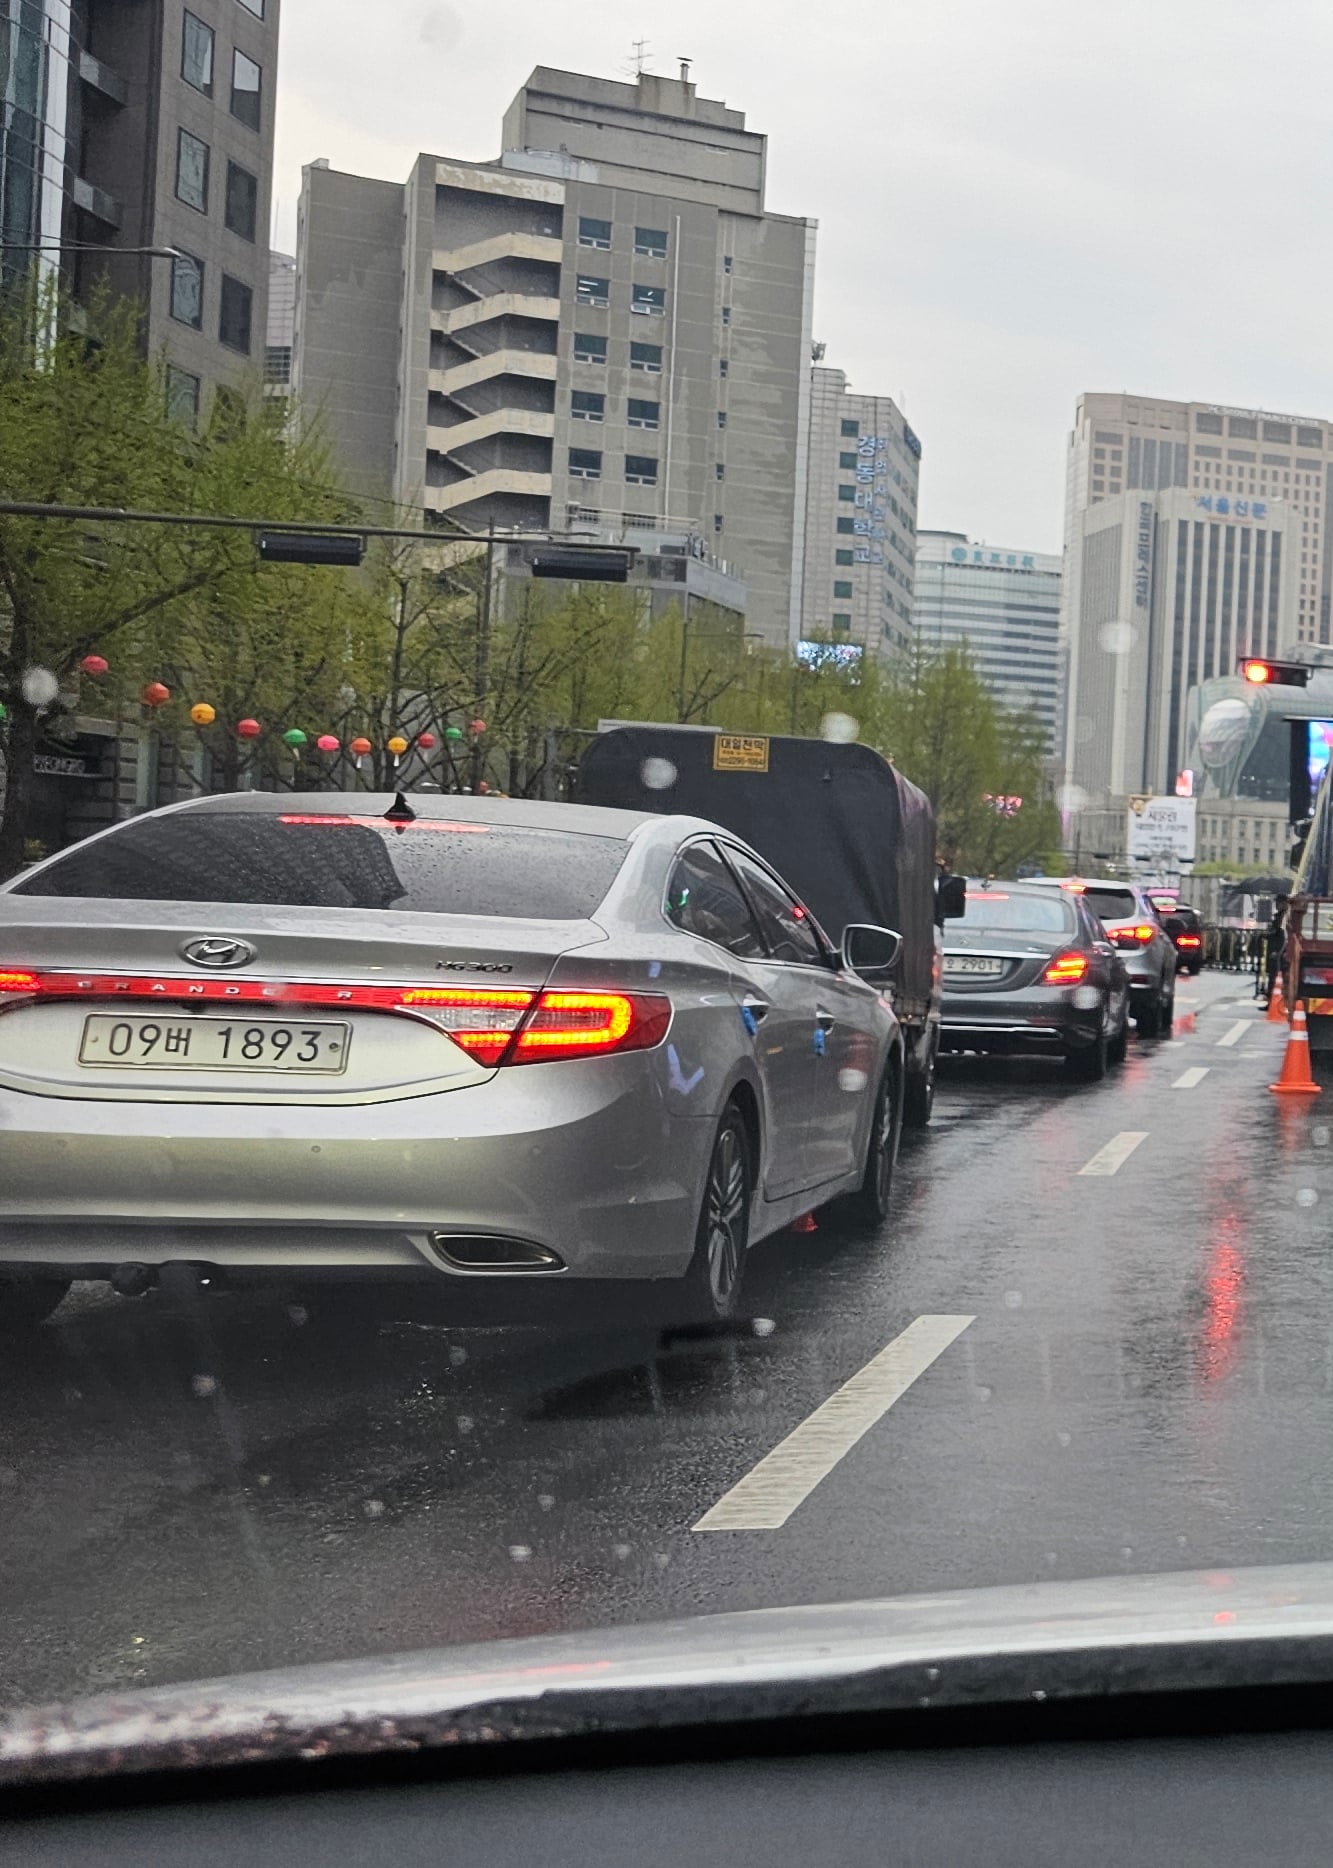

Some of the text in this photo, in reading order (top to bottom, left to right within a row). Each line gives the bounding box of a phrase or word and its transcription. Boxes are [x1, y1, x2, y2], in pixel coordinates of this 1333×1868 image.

[854, 435, 876, 563] 경동대학교
[436, 960, 513, 973] HG300
[961, 958, 994, 970] 2901
[77, 981, 353, 1000] GRANDER
[108, 1023, 322, 1062] 09버 1893
